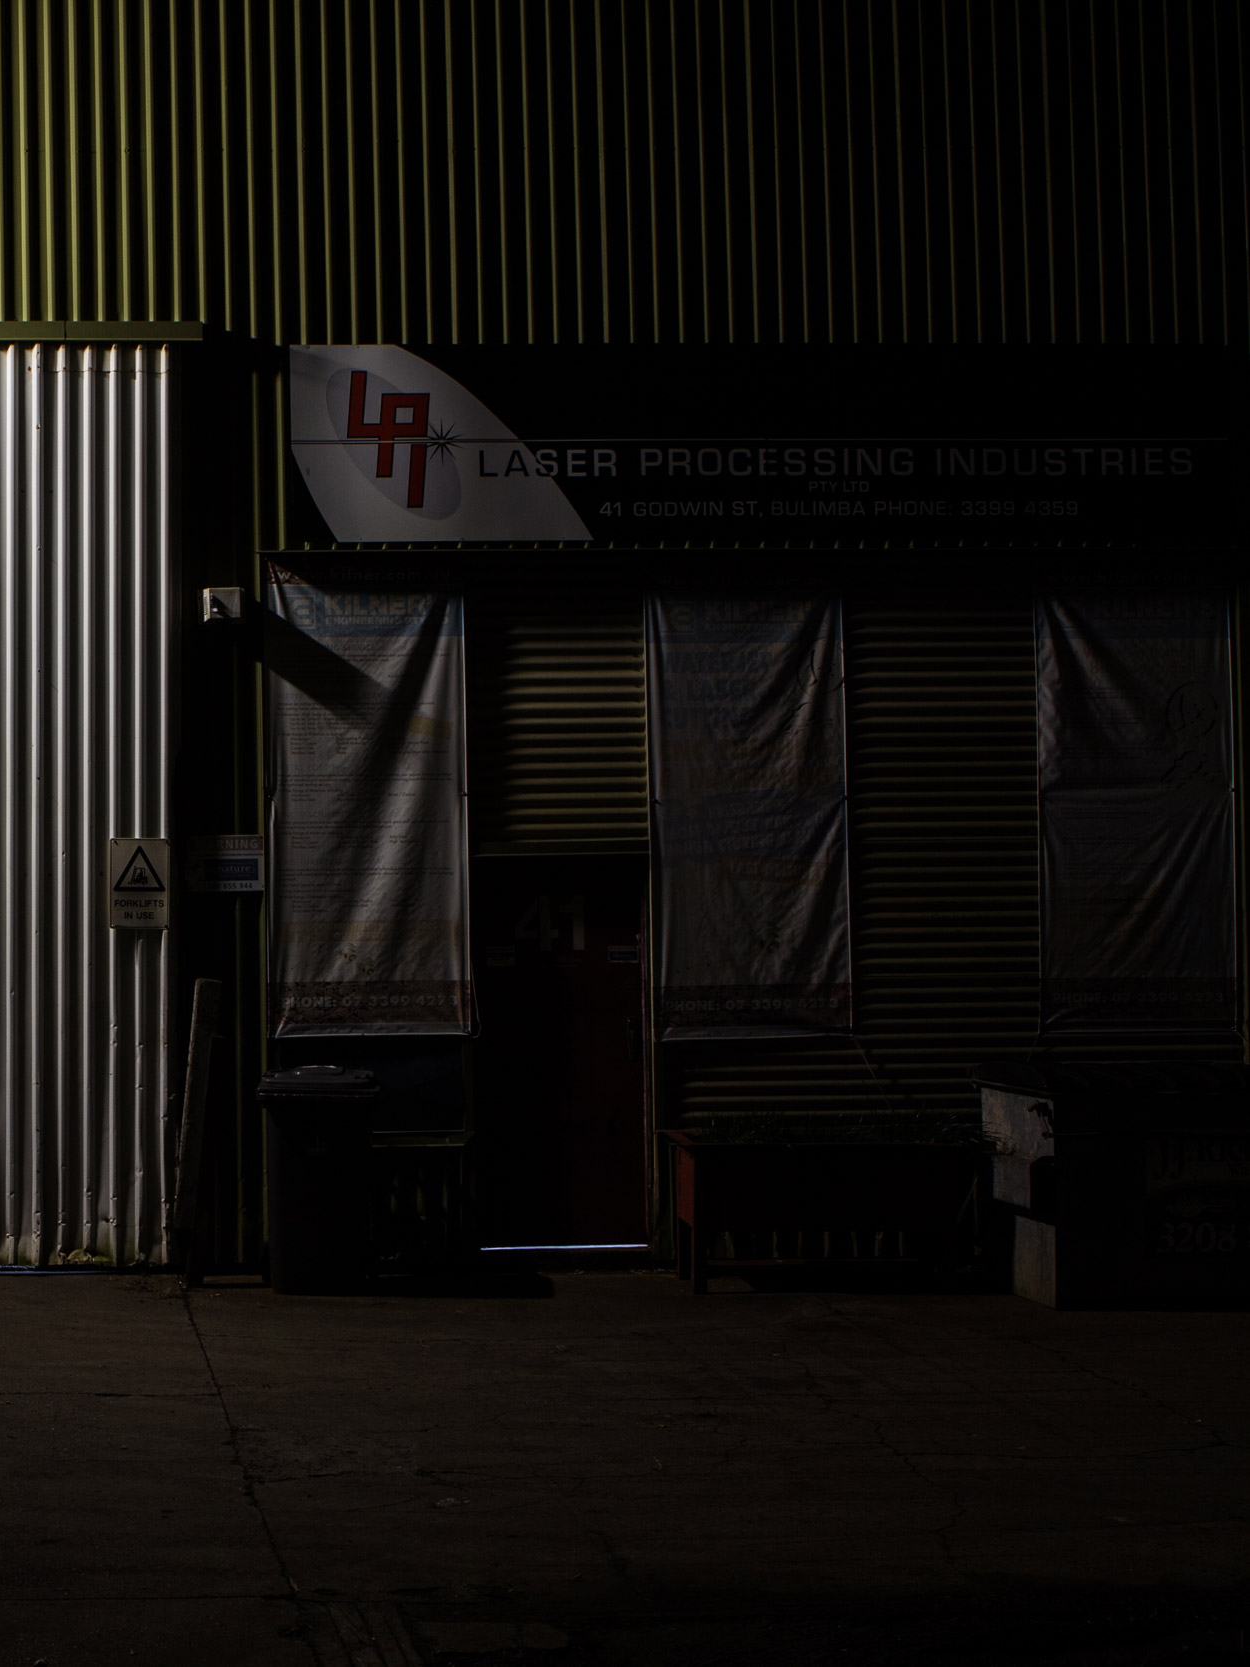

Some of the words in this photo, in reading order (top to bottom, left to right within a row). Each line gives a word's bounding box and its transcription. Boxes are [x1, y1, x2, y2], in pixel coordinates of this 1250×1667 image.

[479, 447, 619, 478] LASER
[640, 447, 914, 478] PROCESSING
[936, 447, 1193, 477] INDUSTRIES
[808, 481, 838, 492] PTY
[843, 481, 870, 492] LTD
[599, 501, 623, 517] 41
[633, 501, 723, 517] GODWIN
[771, 500, 866, 517] BULIMBA
[875, 500, 952, 517] PHONE:
[961, 500, 1015, 517] 3399
[1023, 500, 1079, 517] 4359
[326, 593, 435, 616] KILNER'
[114, 899, 165, 908] FORKLIFTS
[124, 911, 133, 919] IN
[136, 911, 155, 919] USE
[513, 895, 586, 951] 41
